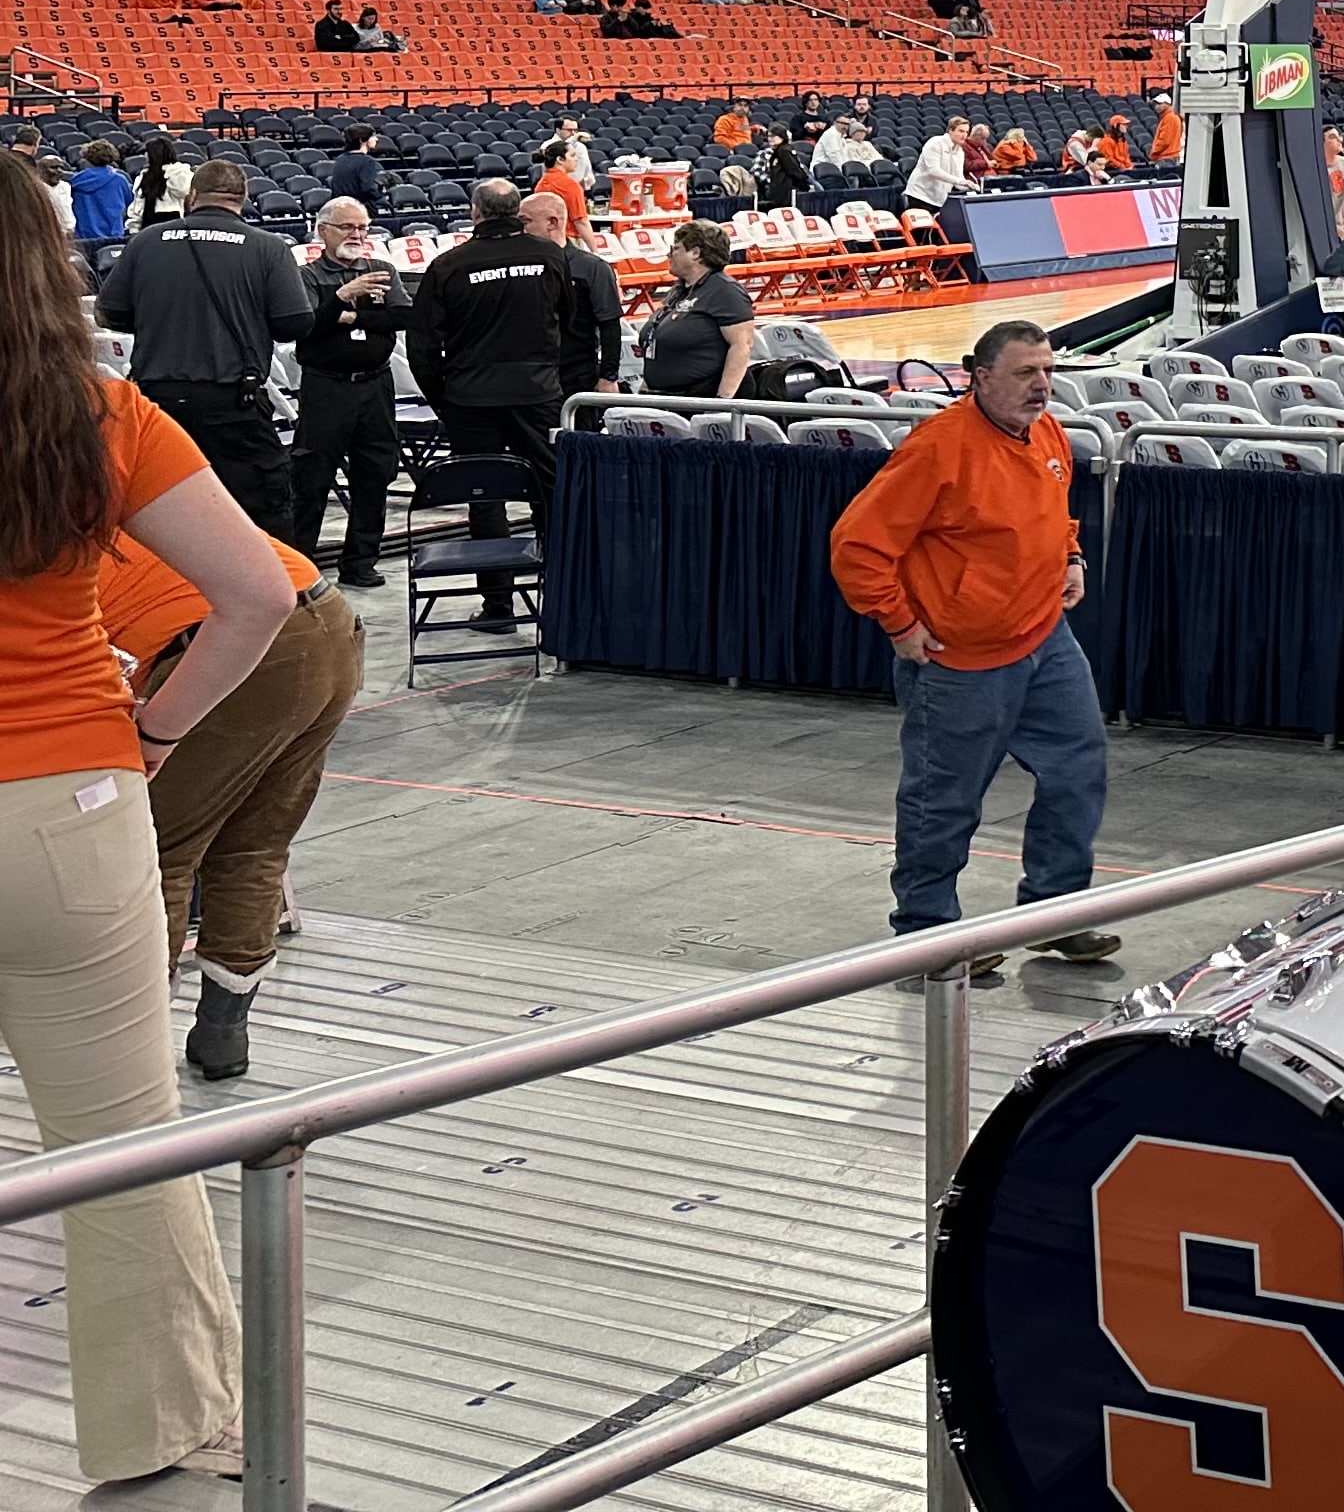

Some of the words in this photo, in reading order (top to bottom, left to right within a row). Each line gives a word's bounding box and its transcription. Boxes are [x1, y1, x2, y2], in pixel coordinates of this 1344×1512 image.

[1256, 60, 1304, 103] LIBMAN
[161, 229, 246, 246] SUPERVISOR
[468, 268, 508, 285] EVENT
[509, 264, 545, 281] STAFF
